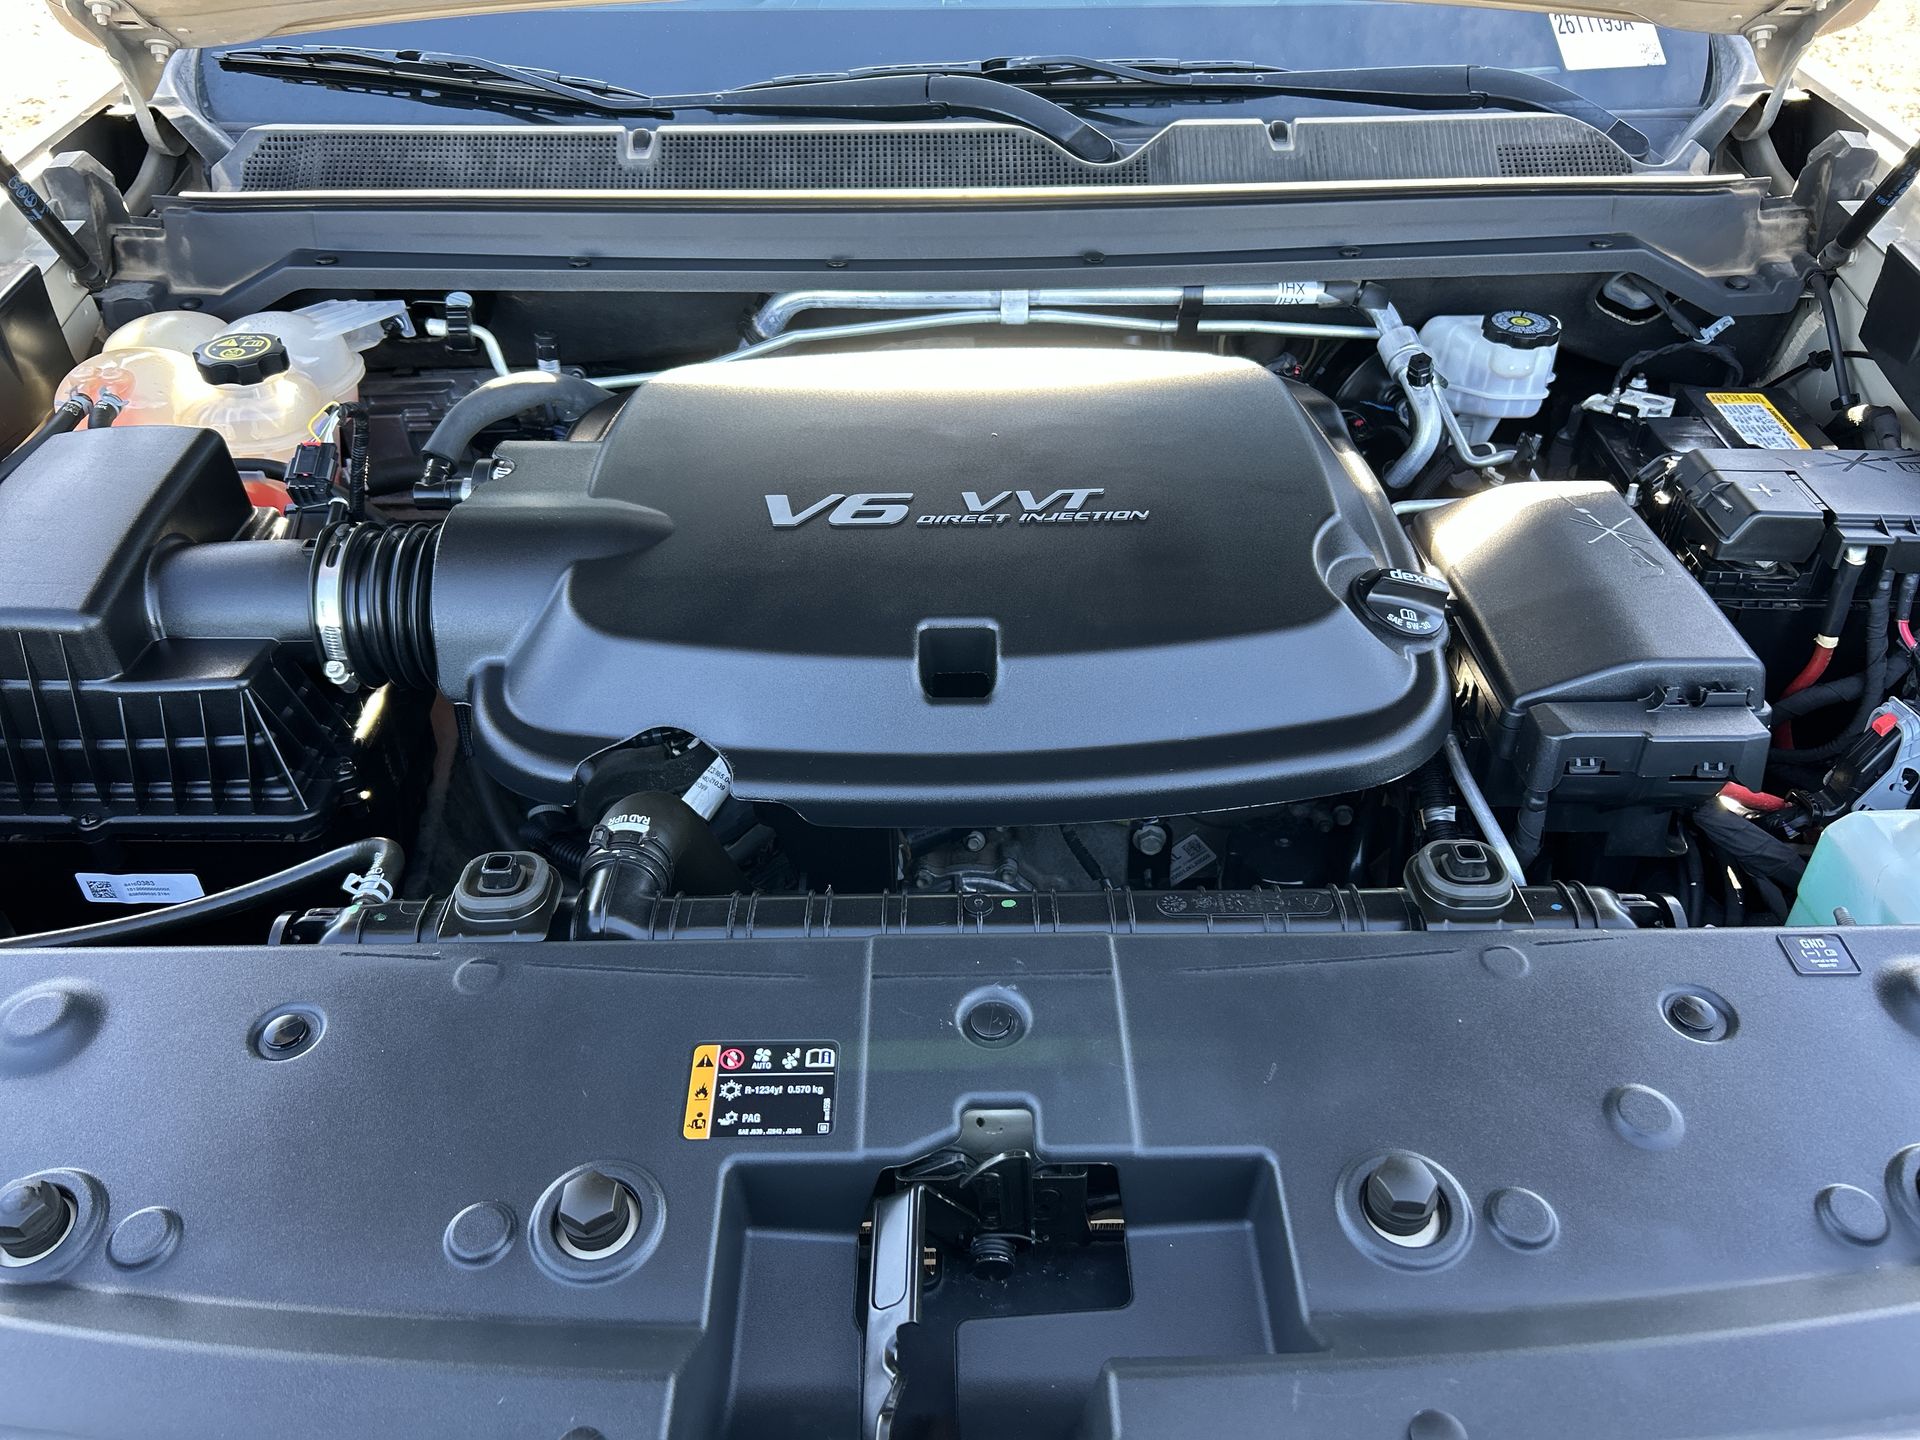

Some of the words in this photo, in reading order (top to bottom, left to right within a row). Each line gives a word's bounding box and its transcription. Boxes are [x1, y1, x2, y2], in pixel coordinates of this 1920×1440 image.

[765, 492, 914, 527] V6
[961, 488, 1105, 512] VVT
[916, 513, 1011, 528] DIRECT
[1018, 510, 1150, 525] INJECTION
[1386, 613, 1403, 626] SAE
[1406, 620, 1431, 630] 5W-30
[608, 814, 628, 826] UPR
[629, 814, 651, 825] RAD
[1800, 939, 1827, 949] GND
[752, 1062, 772, 1070] AUTO
[744, 1085, 783, 1096] R-1234yf
[787, 1085, 811, 1094] 0.570
[812, 1085, 824, 1095] kg
[742, 1113, 761, 1123] PAG
